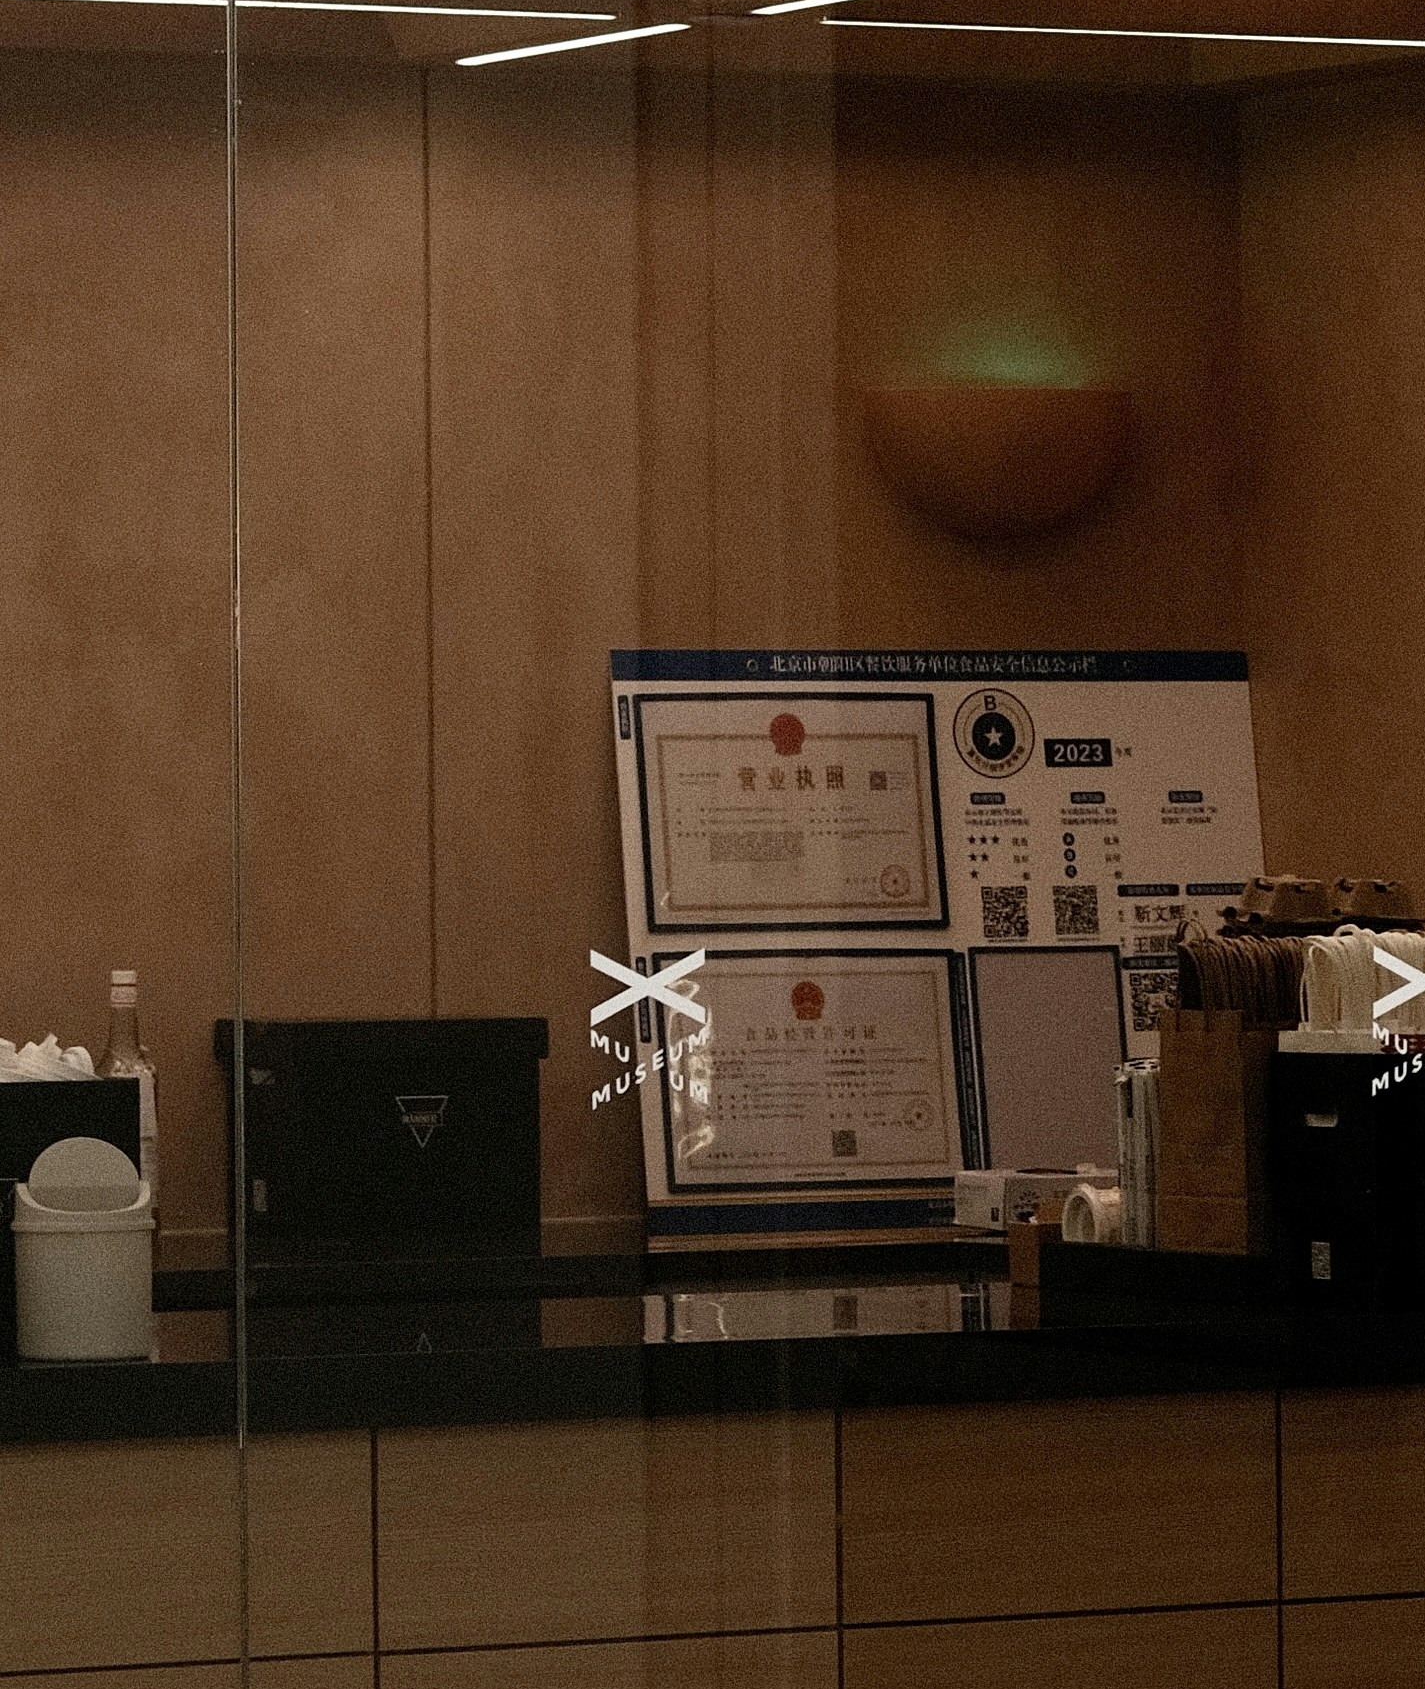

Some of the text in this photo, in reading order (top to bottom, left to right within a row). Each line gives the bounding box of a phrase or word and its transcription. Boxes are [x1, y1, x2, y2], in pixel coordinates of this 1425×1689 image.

[983, 695, 997, 711] B
[1053, 743, 1104, 763] 2023
[738, 764, 845, 792] 营业执照
